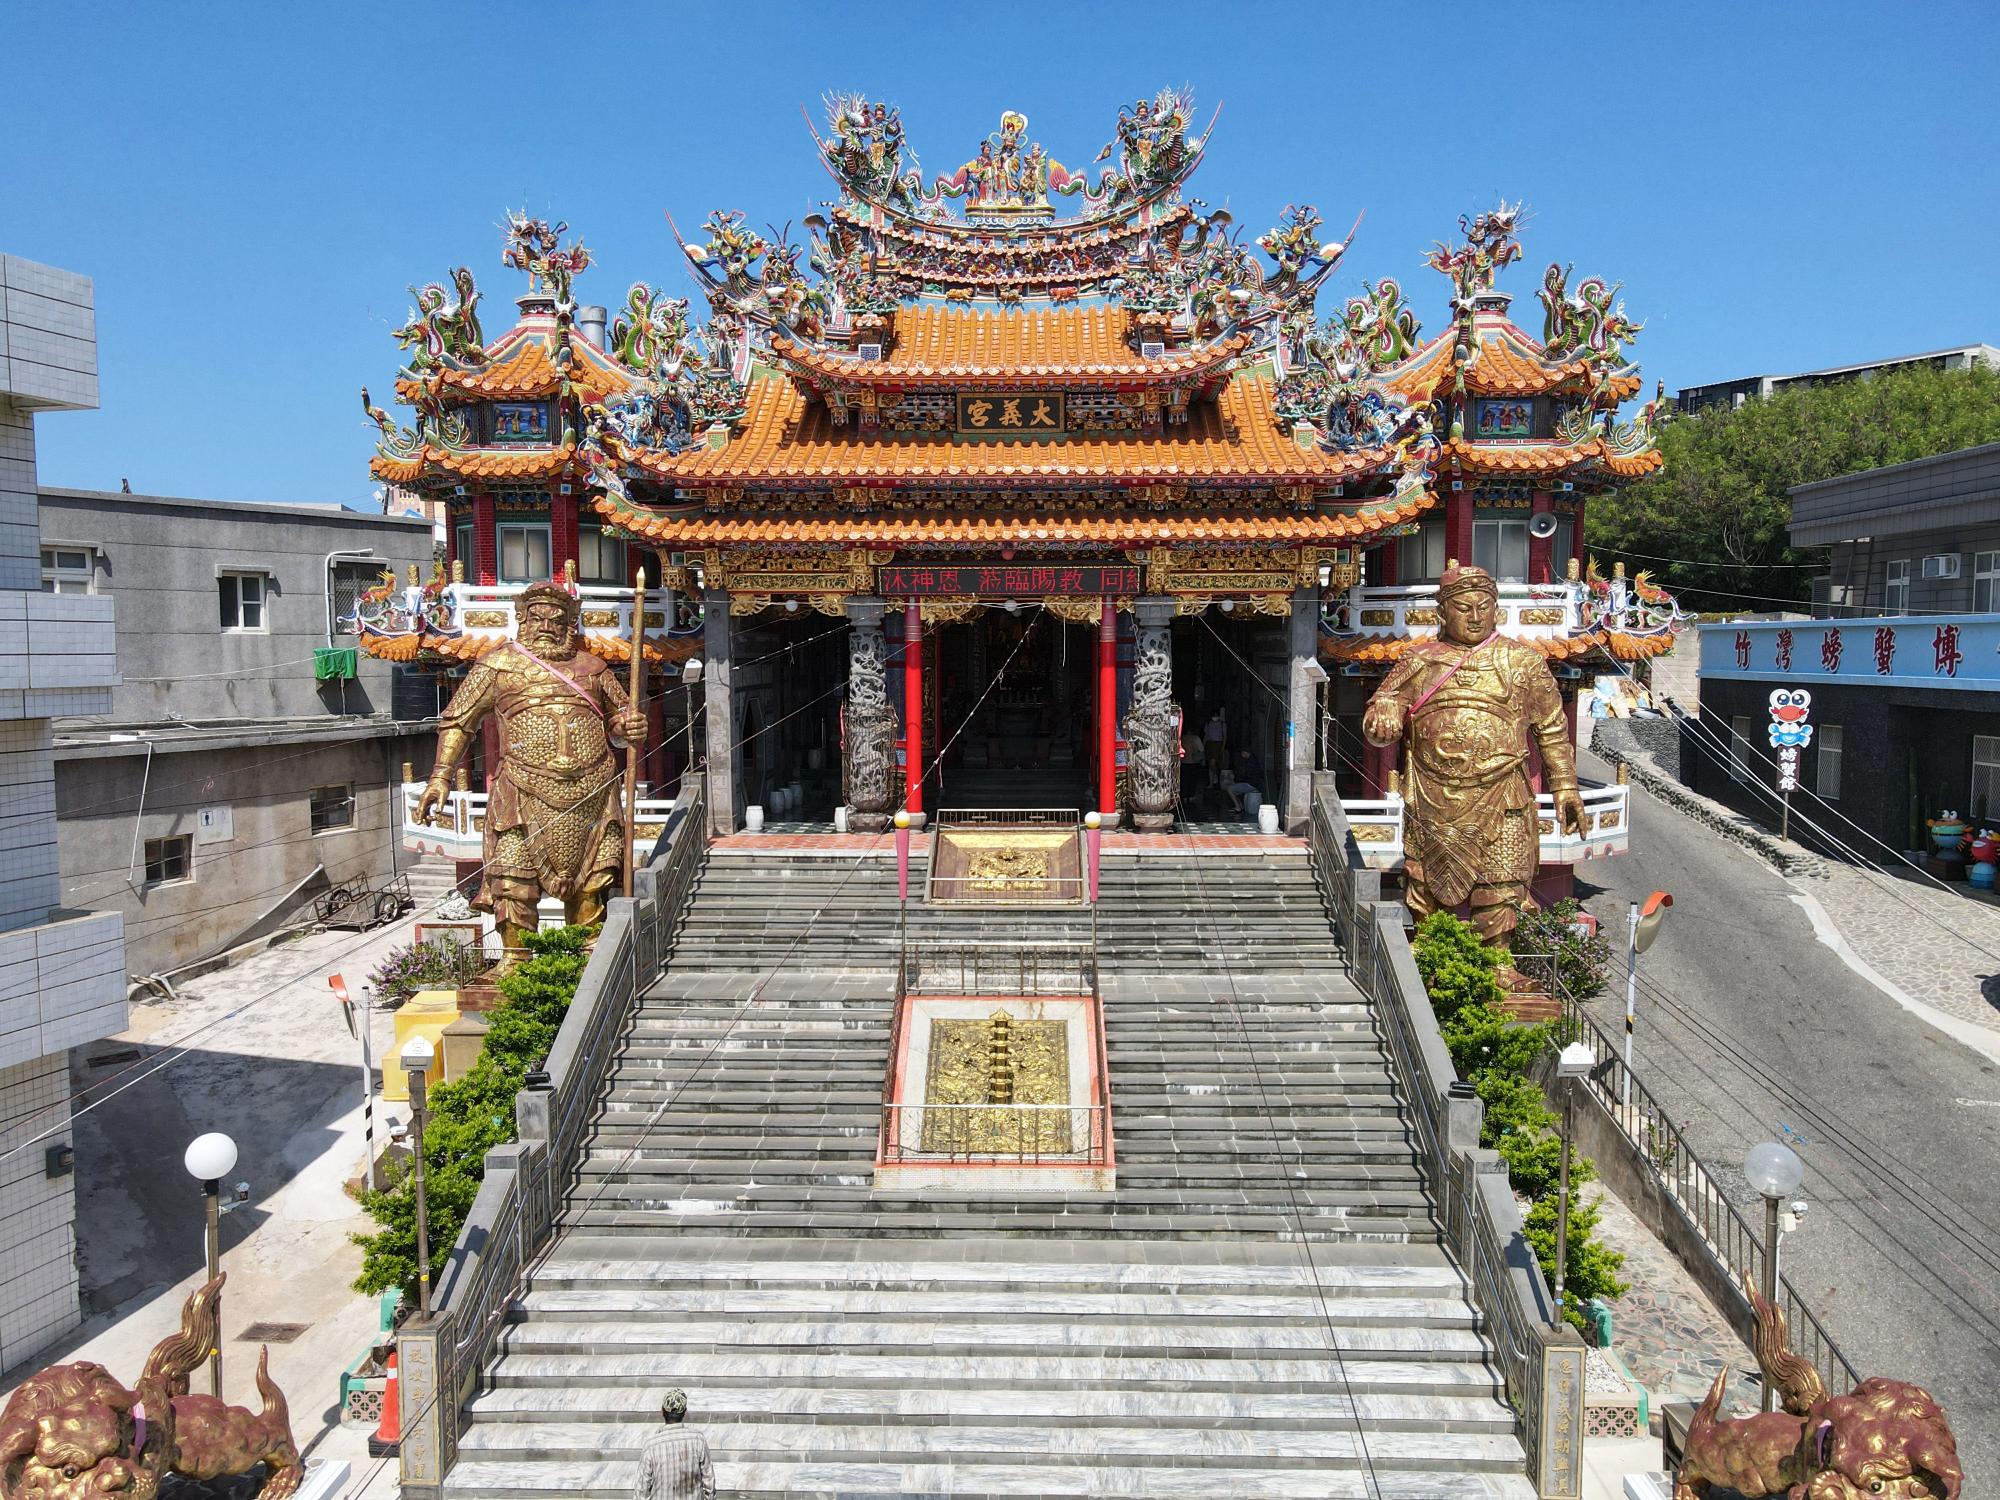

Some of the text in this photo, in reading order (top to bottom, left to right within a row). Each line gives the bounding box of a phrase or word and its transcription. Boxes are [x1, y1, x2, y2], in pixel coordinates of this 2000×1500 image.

[1735, 624, 2000, 677] 竹灣螃蟹博
[1778, 748, 1798, 791] 螃蟹館
